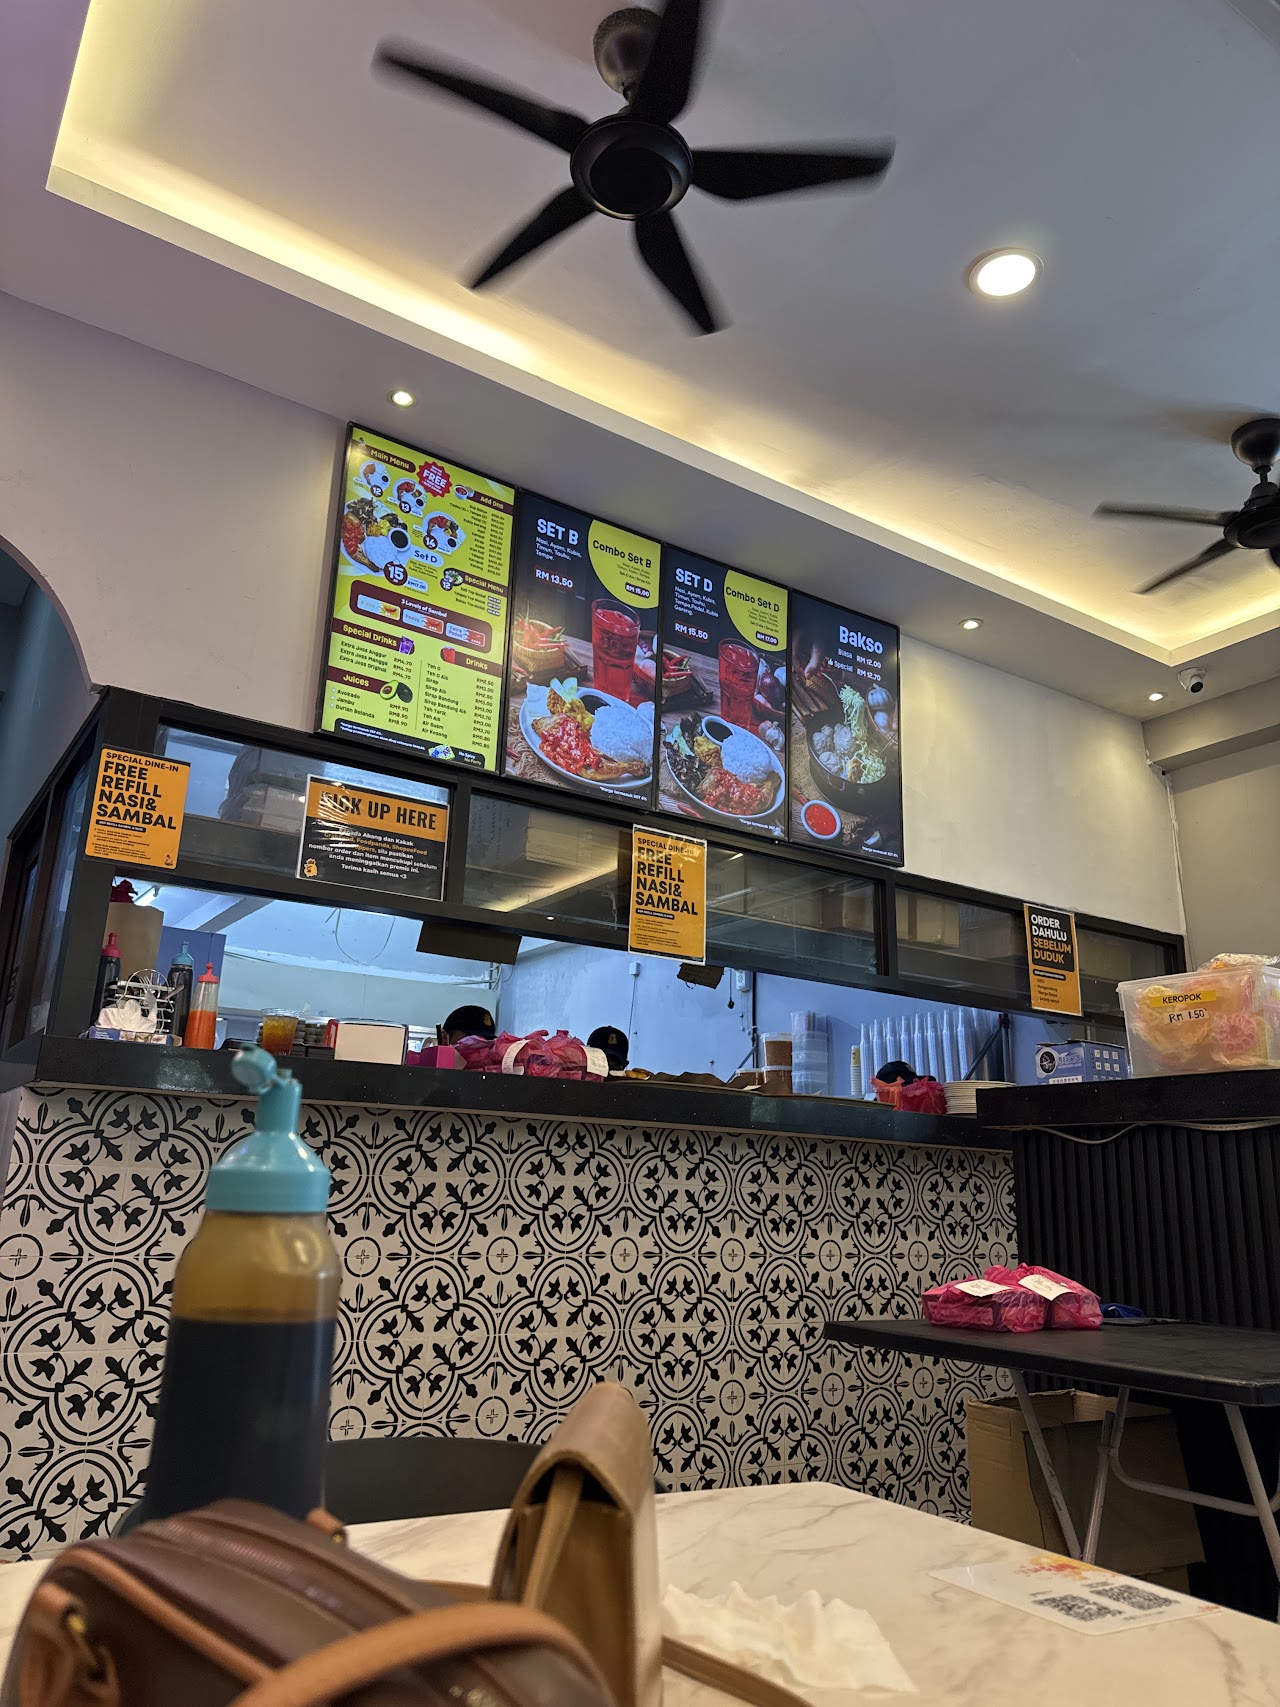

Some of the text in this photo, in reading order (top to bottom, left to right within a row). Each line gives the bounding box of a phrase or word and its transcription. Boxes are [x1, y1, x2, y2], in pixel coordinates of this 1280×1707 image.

[371, 450, 410, 469] Main Menu
[423, 470, 447, 488] FREE
[373, 487, 382, 495] 12
[401, 504, 410, 512] 13
[480, 496, 492, 505] Add
[537, 518, 579, 545] SET B
[426, 538, 436, 548] 14
[414, 550, 438, 563] Set D
[593, 540, 652, 568] Combo Set B
[388, 565, 404, 580] 15
[536, 569, 574, 588] RM 13.50
[676, 568, 712, 592] SET D
[464, 576, 504, 594] Special Menu
[406, 600, 422, 610] Levels
[726, 586, 780, 612] Combo Set D
[343, 624, 398, 646] Special Drinks
[675, 623, 708, 640] RM 15.50
[341, 641, 355, 650] Extra
[840, 626, 883, 654] Bakso
[340, 648, 354, 656] Extra
[340, 655, 354, 664] Extra
[466, 658, 488, 670] Drinks
[856, 655, 866, 664] RM
[866, 658, 882, 668] 12.00
[834, 660, 881, 682] Special RM 12.70
[343, 674, 370, 686] Juices
[390, 704, 408, 712] RM9.90
[104, 760, 148, 780] FREE
[106, 752, 178, 772] SPECIAL DINE-IN
[102, 774, 162, 798] REFILL
[98, 788, 158, 812] NASI&
[96, 804, 177, 830] SAMBAL
[368, 800, 391, 820] UP
[396, 806, 437, 830] HERE
[356, 837, 428, 856] Foodpanda, ShopeeFood
[362, 832, 382, 842] Abang
[396, 838, 414, 846] Kakak
[638, 838, 694, 855] SPECIAL DINE-IN
[346, 856, 389, 868] meninggalkan
[364, 852, 382, 860] item
[380, 856, 413, 866] mencukupi
[389, 850, 414, 859] pastikan
[638, 846, 672, 866] FREE
[341, 864, 362, 872] Terima
[637, 861, 684, 884] REFILL
[636, 876, 682, 898] NASI&
[635, 892, 698, 916] SAMBAL
[1030, 914, 1060, 930] ORDER
[1032, 926, 1067, 942] DAHULU
[1033, 938, 1072, 954] SEBELUM
[1034, 948, 1064, 964] DUDUK
[1162, 993, 1202, 1004] KEROPOK
[1168, 1014, 1184, 1024] RM
